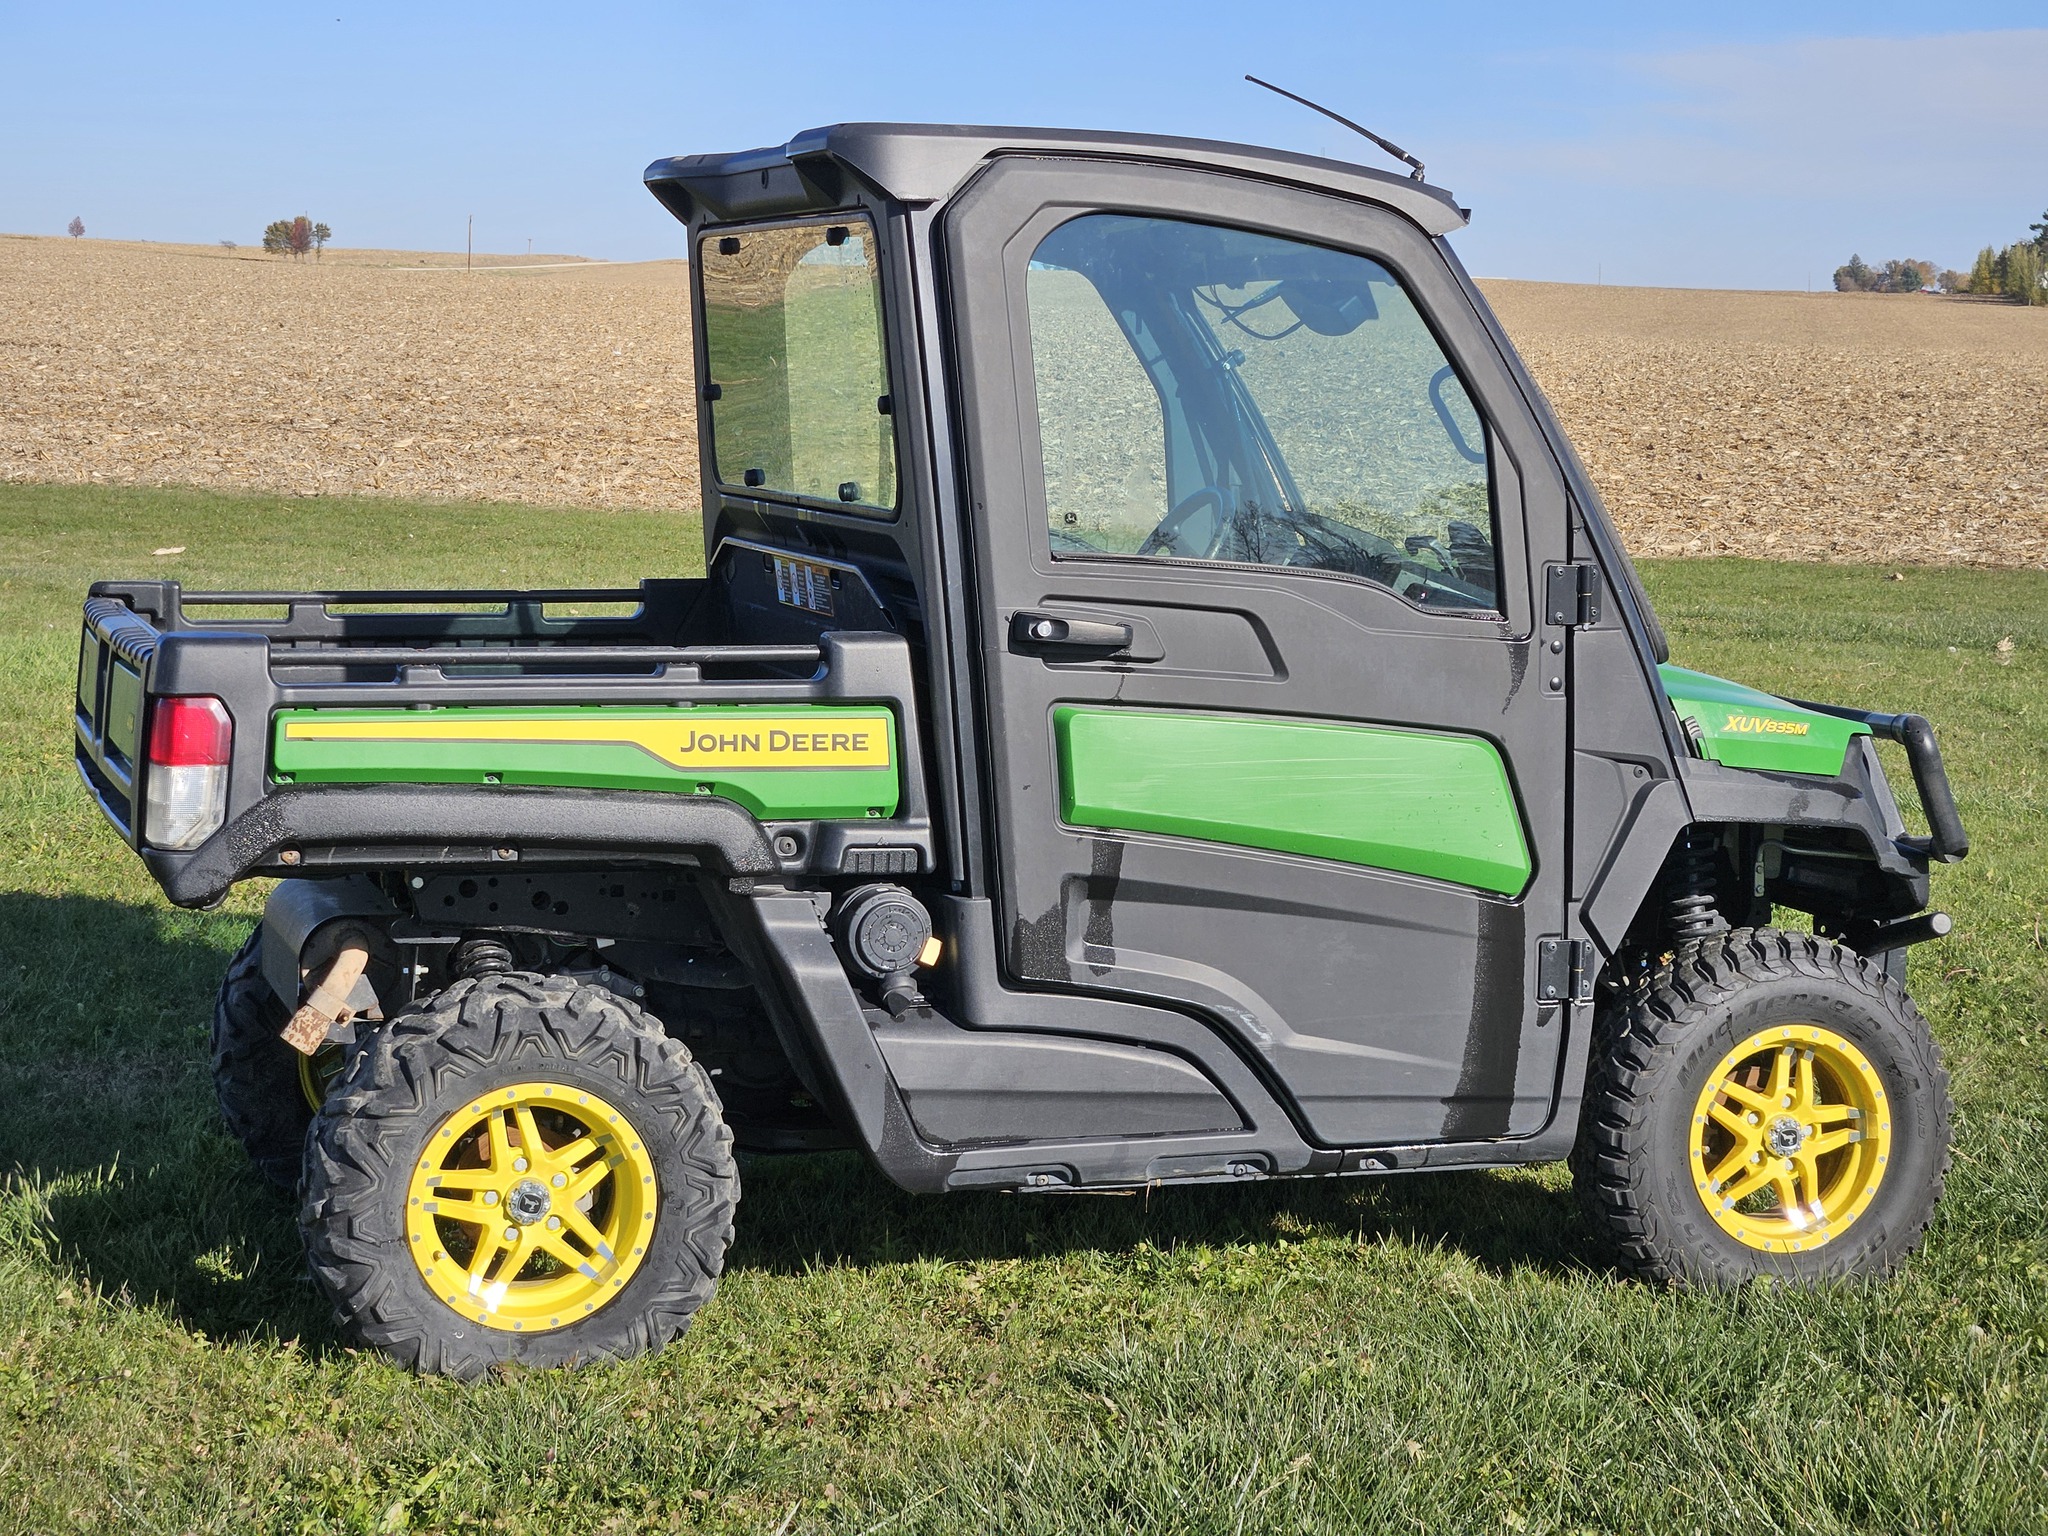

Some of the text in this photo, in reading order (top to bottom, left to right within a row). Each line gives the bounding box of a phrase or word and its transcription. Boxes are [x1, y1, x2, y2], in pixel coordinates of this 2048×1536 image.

[1723, 715, 1808, 736] XUV835M
[680, 730, 869, 752] JOHN DEERE
[1677, 993, 1882, 1089] Mud-Terrain
[1880, 1036, 1920, 1094] T/A
